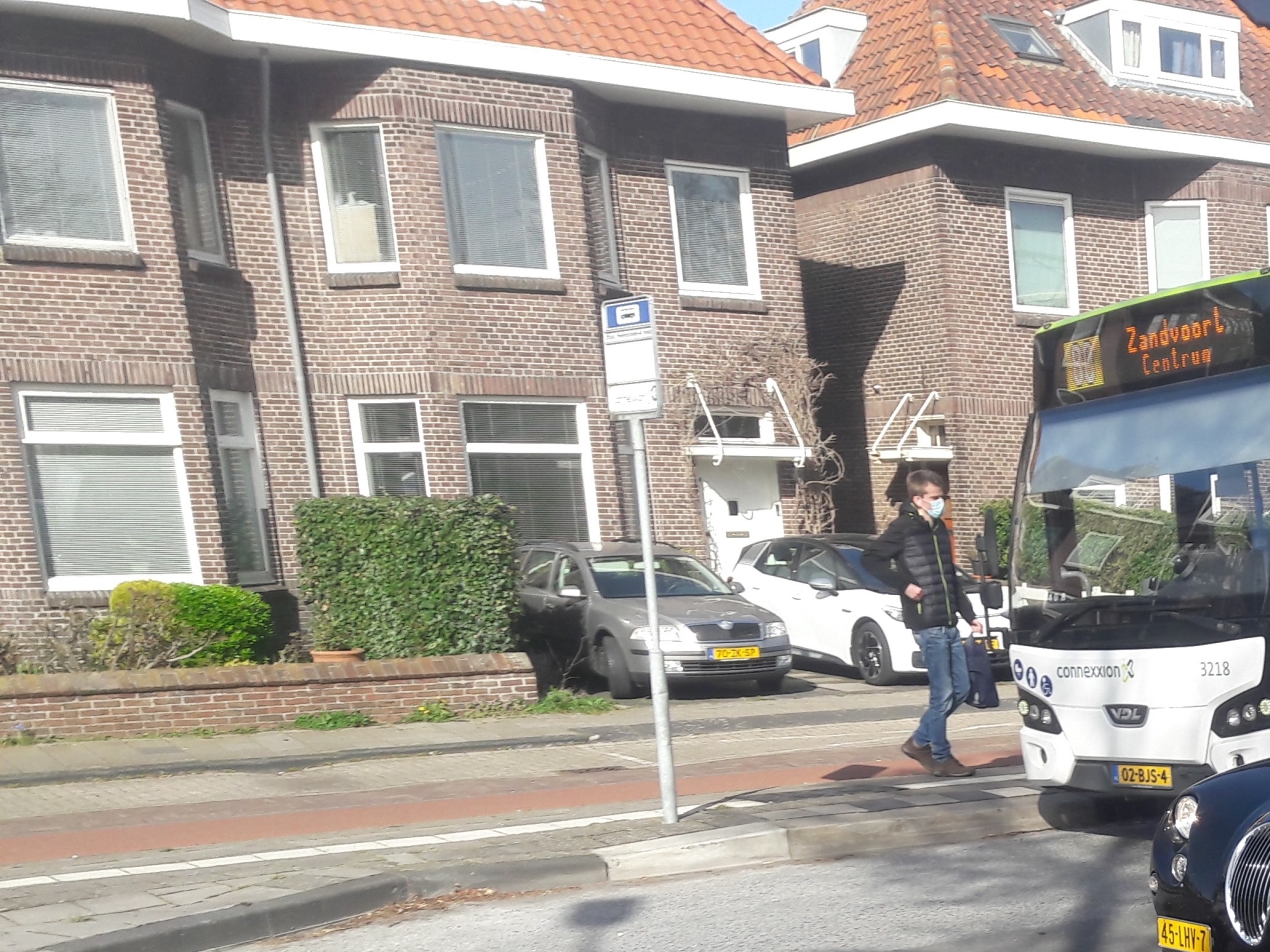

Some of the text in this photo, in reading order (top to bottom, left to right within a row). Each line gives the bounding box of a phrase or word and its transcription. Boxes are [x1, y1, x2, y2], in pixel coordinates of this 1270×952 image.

[1126, 306, 1224, 353] Zandvoort
[1141, 347, 1212, 376] Centrum
[1056, 663, 1121, 679] connexxion
[1200, 660, 1231, 677] 3218
[1109, 707, 1142, 721] VDL
[1121, 767, 1168, 784] 02-BJS-4
[1161, 921, 1206, 952] 45-LHV-7
